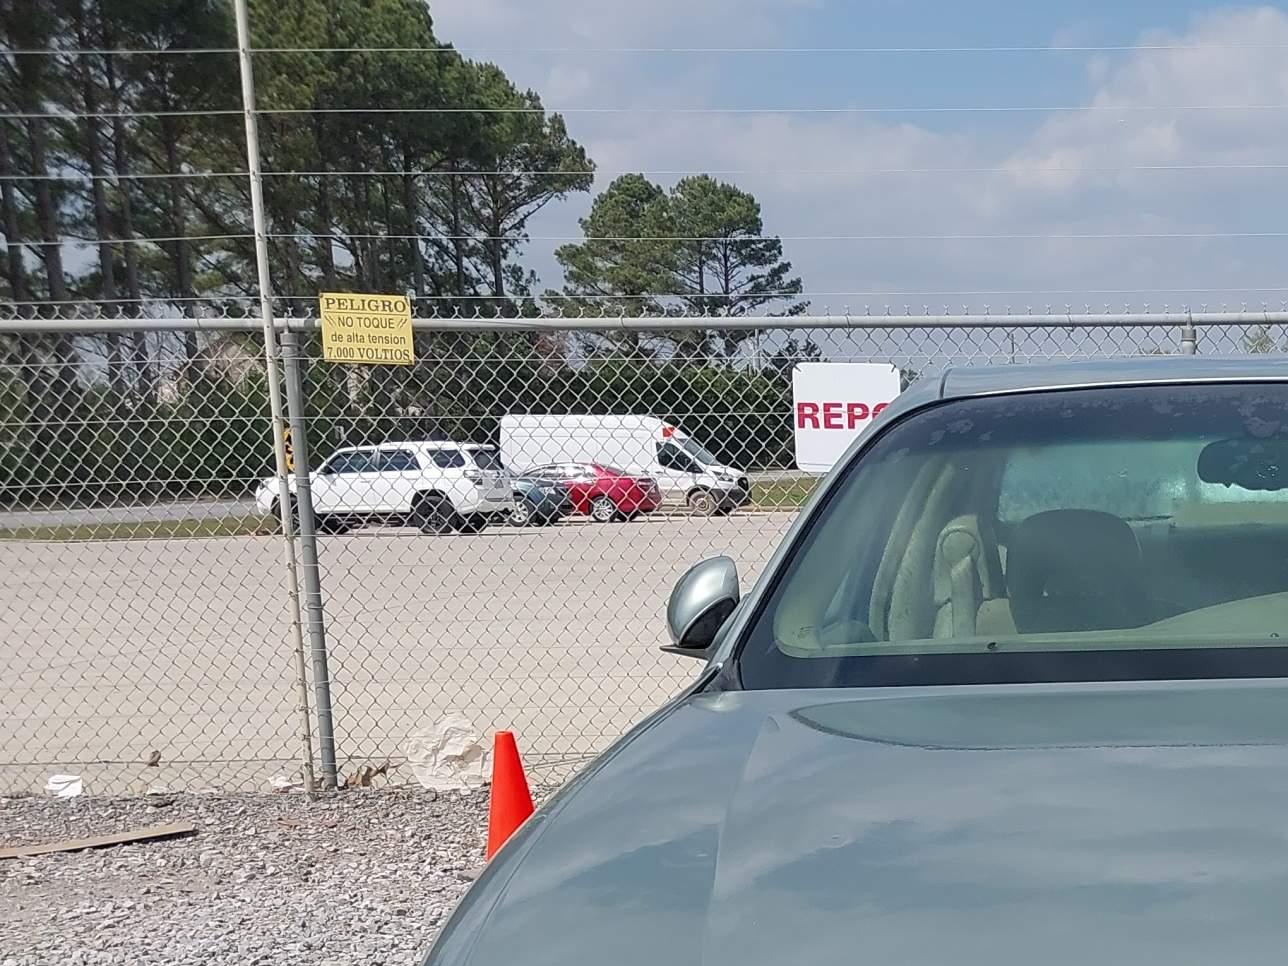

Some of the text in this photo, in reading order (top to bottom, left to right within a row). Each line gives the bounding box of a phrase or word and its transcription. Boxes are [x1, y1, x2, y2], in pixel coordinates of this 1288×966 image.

[324, 297, 407, 313] PELIGRO
[337, 316, 395, 329] NO TOQUE
[331, 331, 406, 345] de alta tension
[356, 347, 410, 361] VOLTIOS
